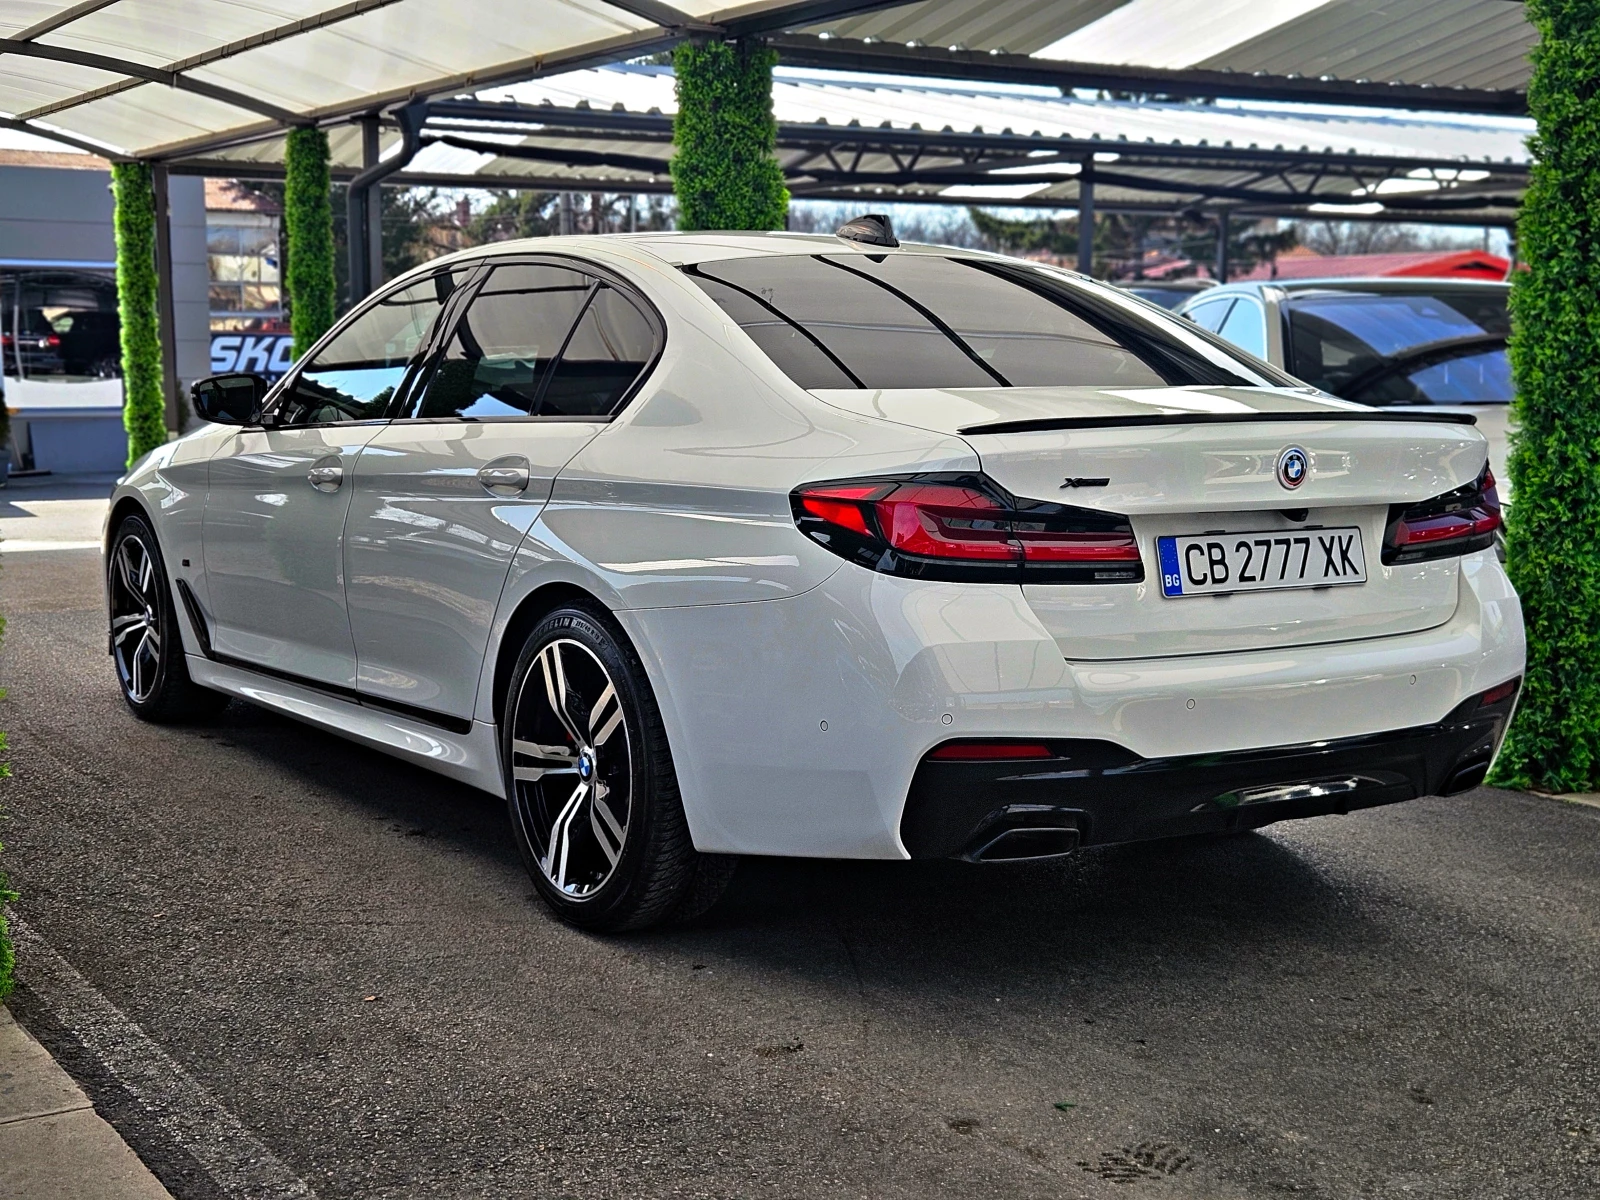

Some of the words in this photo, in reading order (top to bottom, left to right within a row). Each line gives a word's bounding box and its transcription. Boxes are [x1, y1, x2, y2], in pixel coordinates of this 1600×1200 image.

[1184, 542, 1229, 586] CB
[1234, 537, 1311, 583] 2777
[1317, 534, 1360, 577] XK
[1164, 573, 1180, 588] BG
